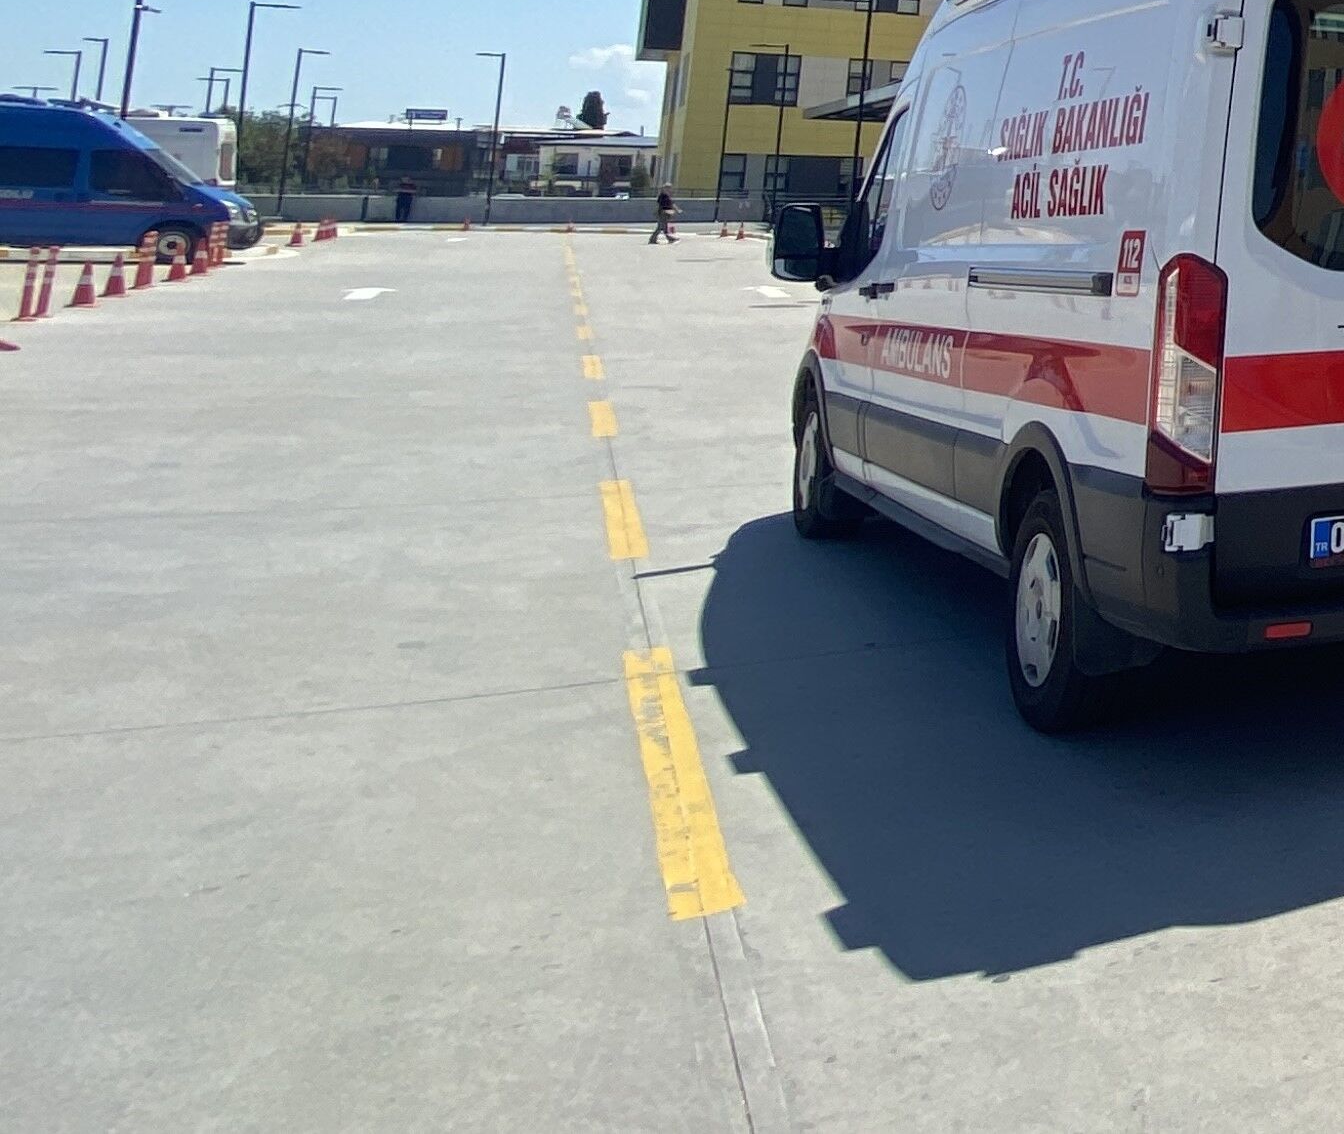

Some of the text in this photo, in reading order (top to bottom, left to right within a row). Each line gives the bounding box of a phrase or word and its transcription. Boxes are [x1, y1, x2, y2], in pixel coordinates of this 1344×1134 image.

[1057, 51, 1085, 101] T.C.
[998, 84, 1150, 162] SAĞLIK BAKANLIĞI
[1010, 158, 1109, 219] ACİL SAĞLIK
[1121, 238, 1141, 269] 112
[881, 327, 955, 379] AMBULANS
[1315, 542, 1328, 551] TR
